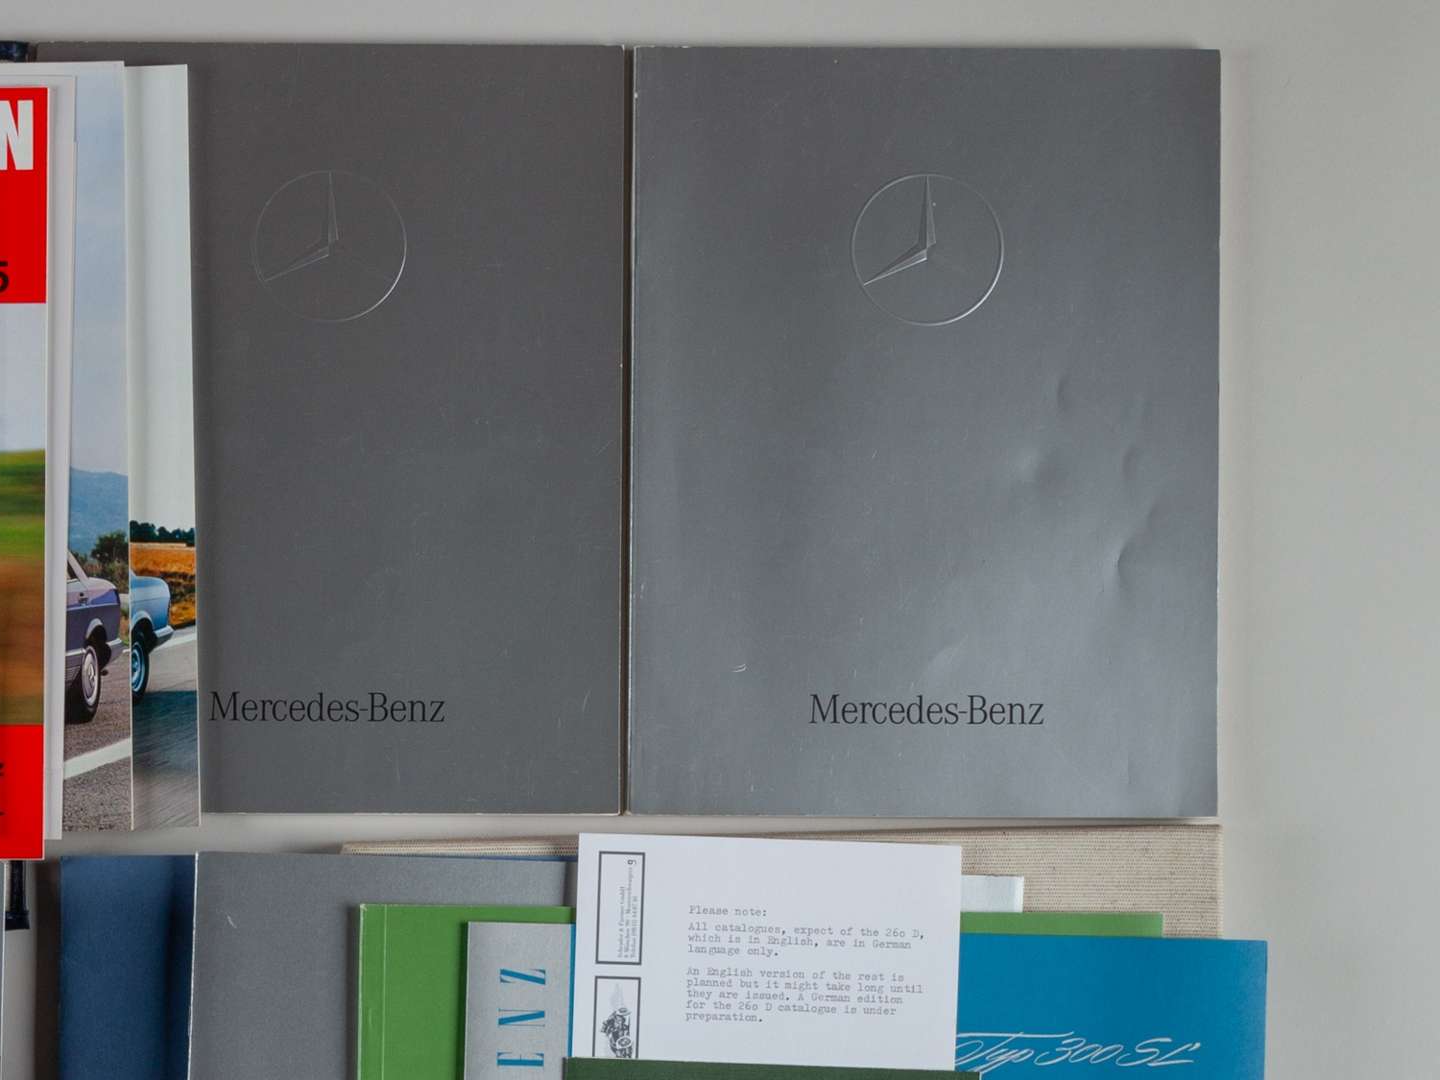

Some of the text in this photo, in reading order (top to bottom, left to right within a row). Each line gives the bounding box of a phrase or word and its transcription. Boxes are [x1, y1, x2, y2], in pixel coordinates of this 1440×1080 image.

[209, 691, 446, 722] Mercedes-Benz
[809, 694, 1045, 726] Mercedes-Benz
[689, 905, 767, 917] Please note:
[688, 922, 707, 932] All
[715, 923, 786, 936] catalogues,
[794, 926, 833, 937] expect
[840, 927, 854, 936] of
[861, 928, 879, 937] the
[688, 934, 911, 950] which is in English, are in German
[688, 945, 779, 958] language only.
[687, 967, 904, 982] An English version of the rest is
[687, 979, 923, 995] planned but it might take long until
[687, 989, 903, 1004] they are issued. German edition
[686, 1000, 705, 1010] for
[713, 1001, 731, 1010] the
[778, 1003, 836, 1015] catalogue
[843, 1005, 856, 1015] is
[863, 1006, 896, 1016] under
[686, 1012, 763, 1023] preparation.
